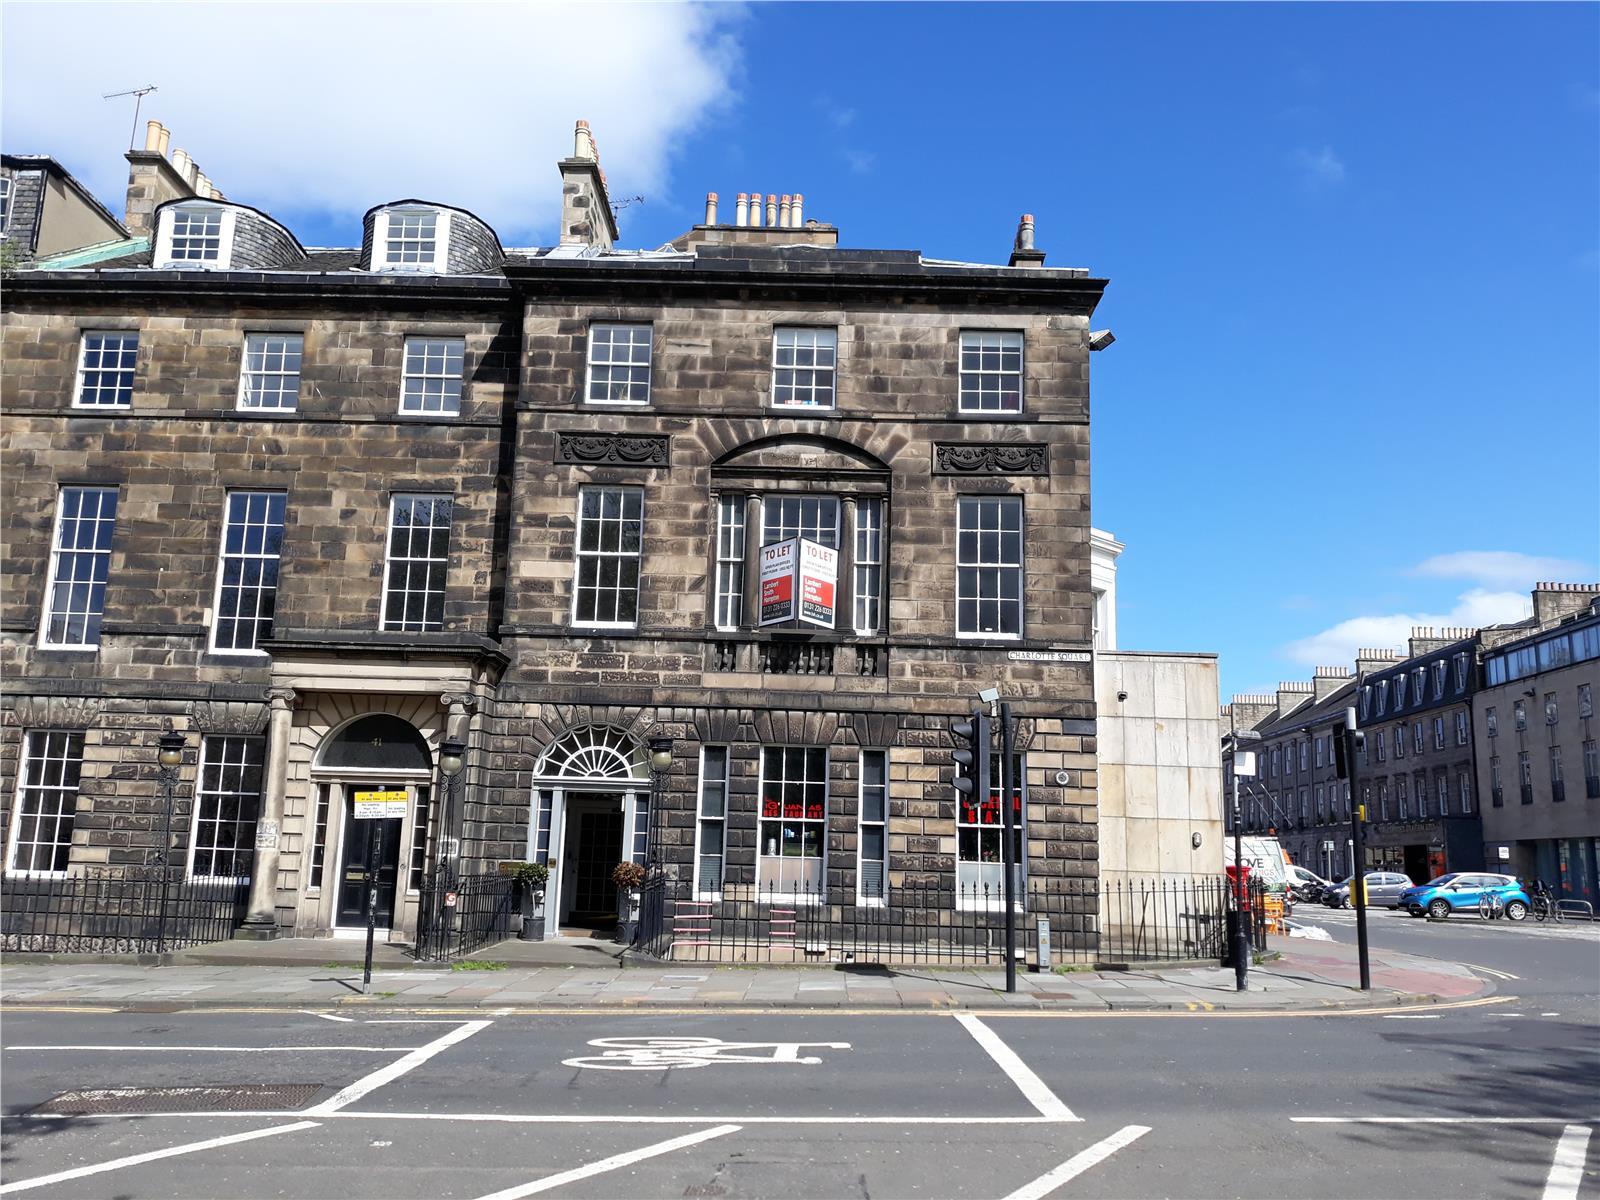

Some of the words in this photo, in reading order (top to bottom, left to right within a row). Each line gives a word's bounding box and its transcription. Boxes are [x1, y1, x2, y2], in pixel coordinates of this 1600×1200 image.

[765, 549, 775, 560] TO
[777, 545, 791, 557] LET
[807, 545, 817, 557] TO
[820, 551, 833, 562] LET
[764, 581, 779, 590] Lambert
[805, 578, 822, 588] Lambert
[764, 589, 775, 597] Smith
[805, 585, 816, 594] Smith
[764, 595, 779, 603] Hampton
[804, 592, 822, 603] Hampton
[804, 602, 814, 610] 0131
[1010, 651, 1056, 660] CHARLOTTE
[1057, 653, 1089, 661] SQUARE
[371, 737, 382, 747] 41
[1236, 857, 1265, 869] OVE
